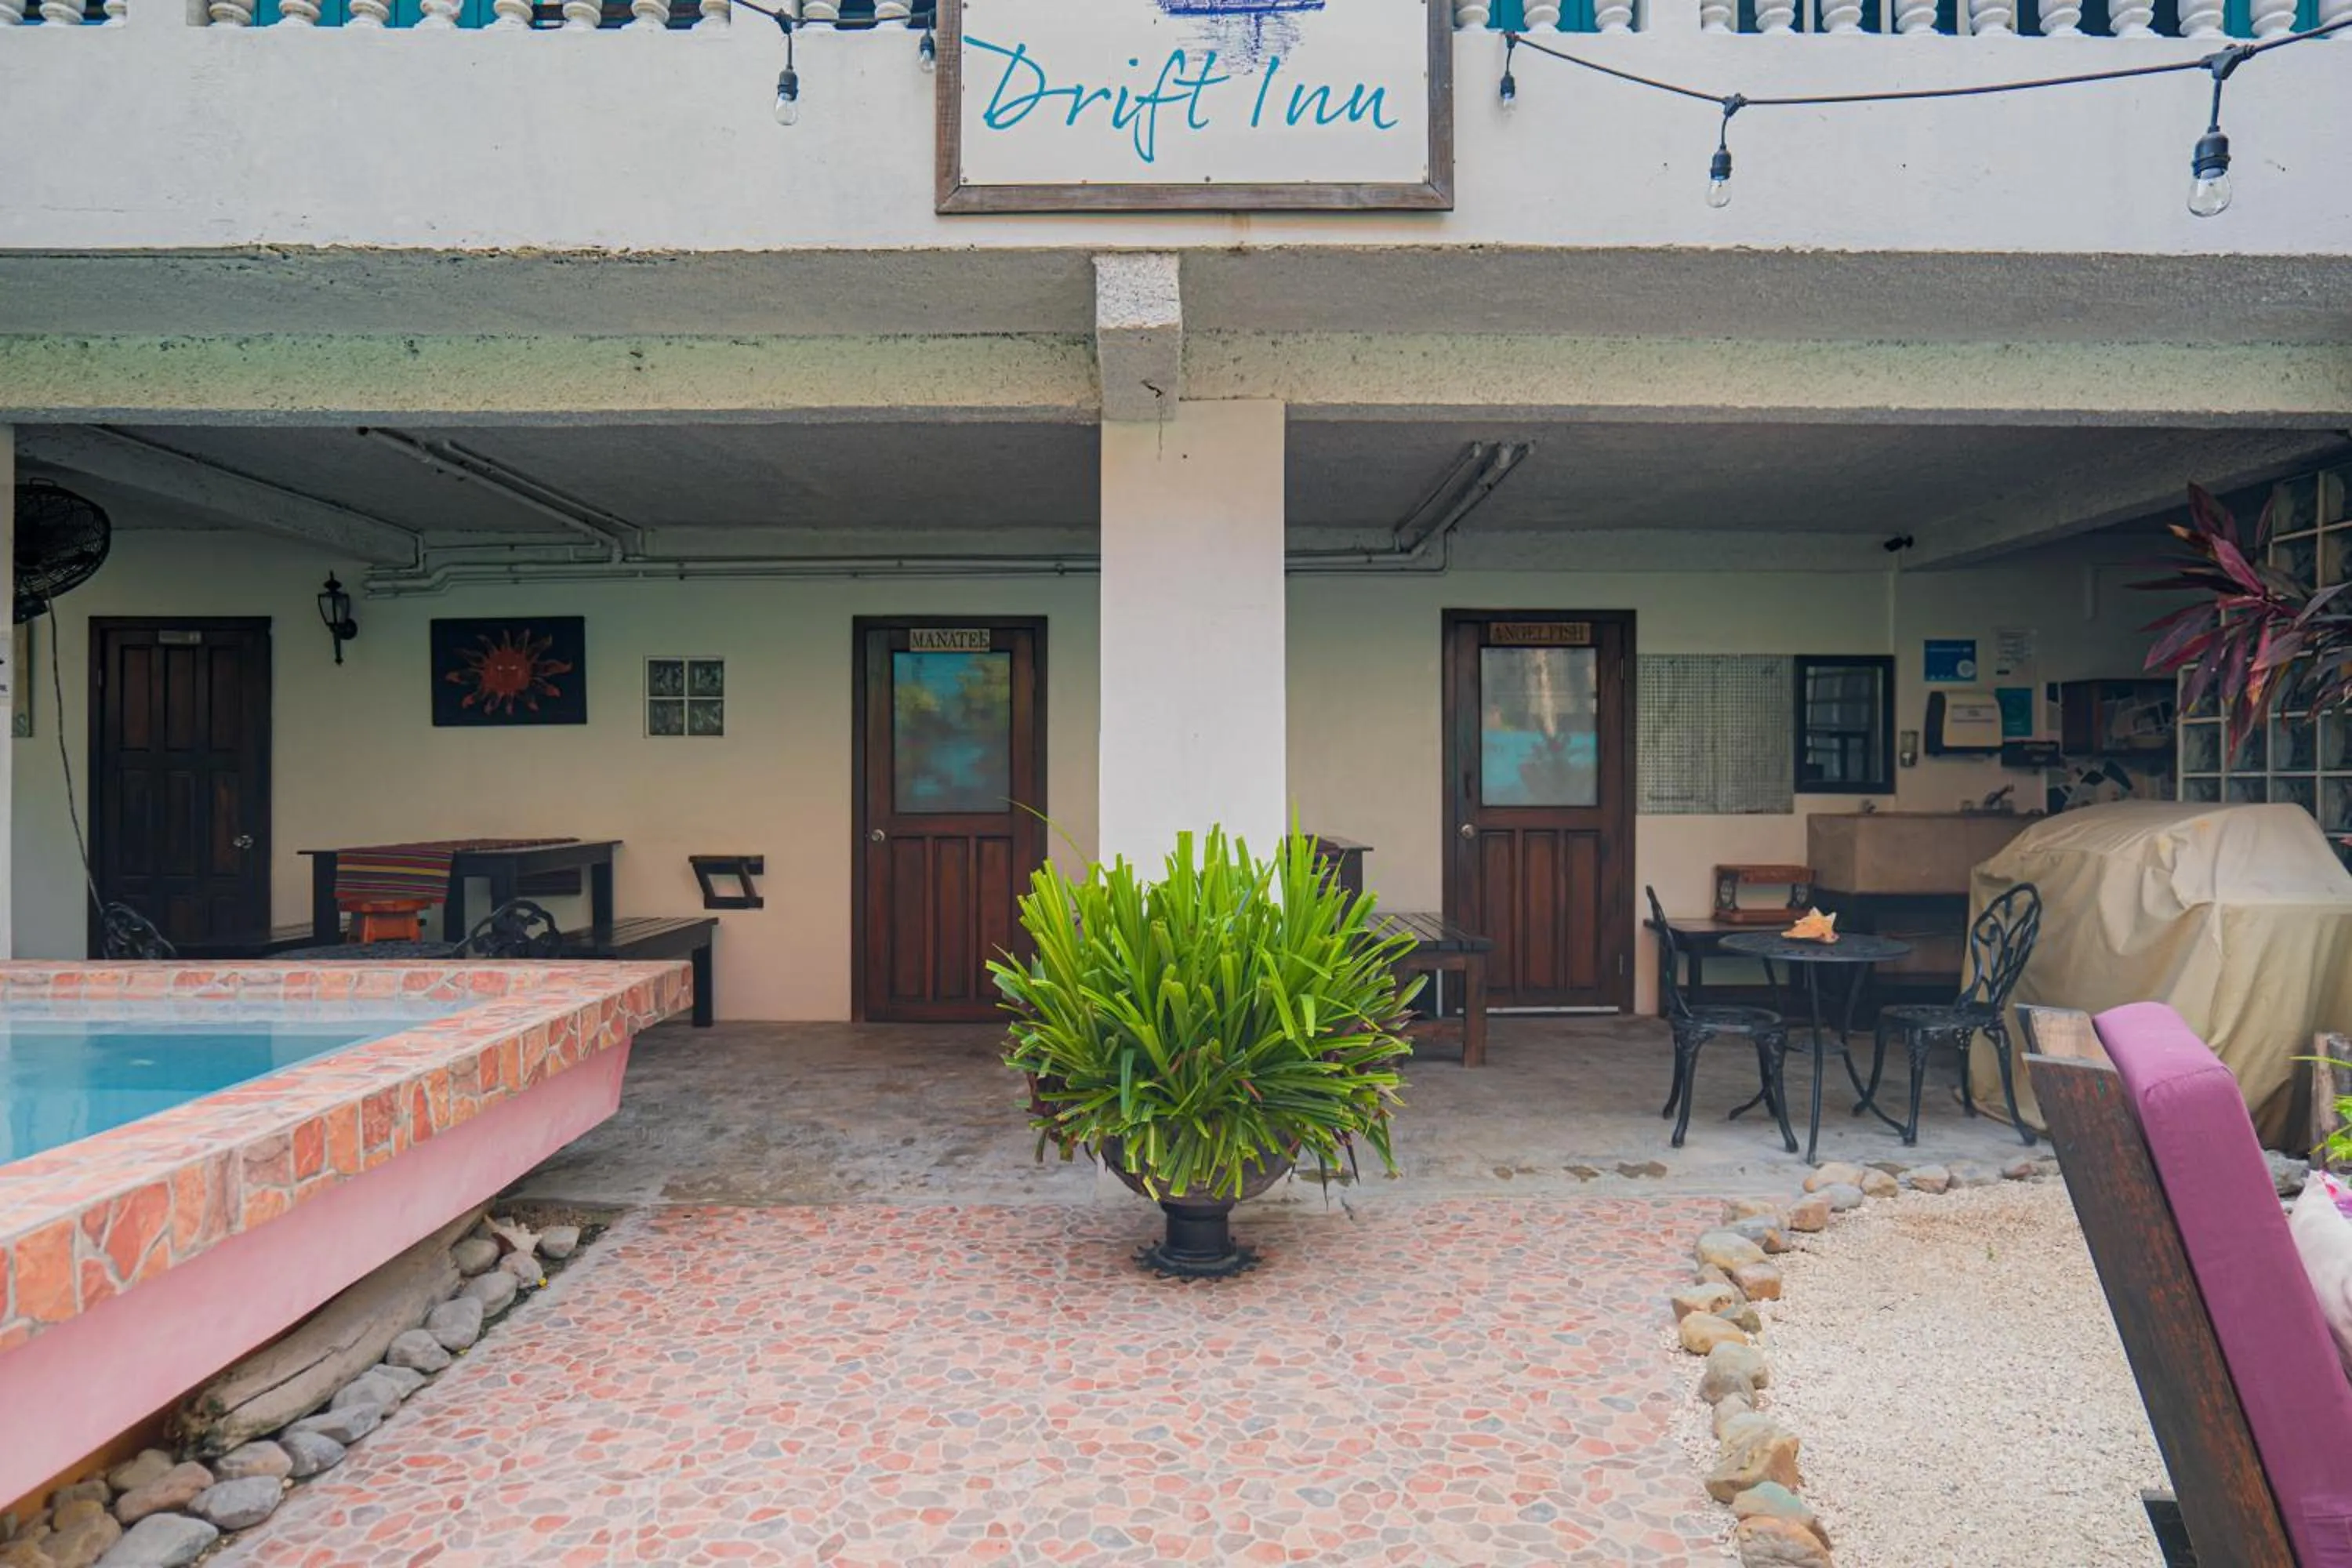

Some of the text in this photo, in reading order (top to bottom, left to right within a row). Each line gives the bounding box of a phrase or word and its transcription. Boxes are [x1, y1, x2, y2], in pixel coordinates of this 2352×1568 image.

[963, 35, 1399, 162] Drift Inn
[913, 630, 990, 648] MANATEE
